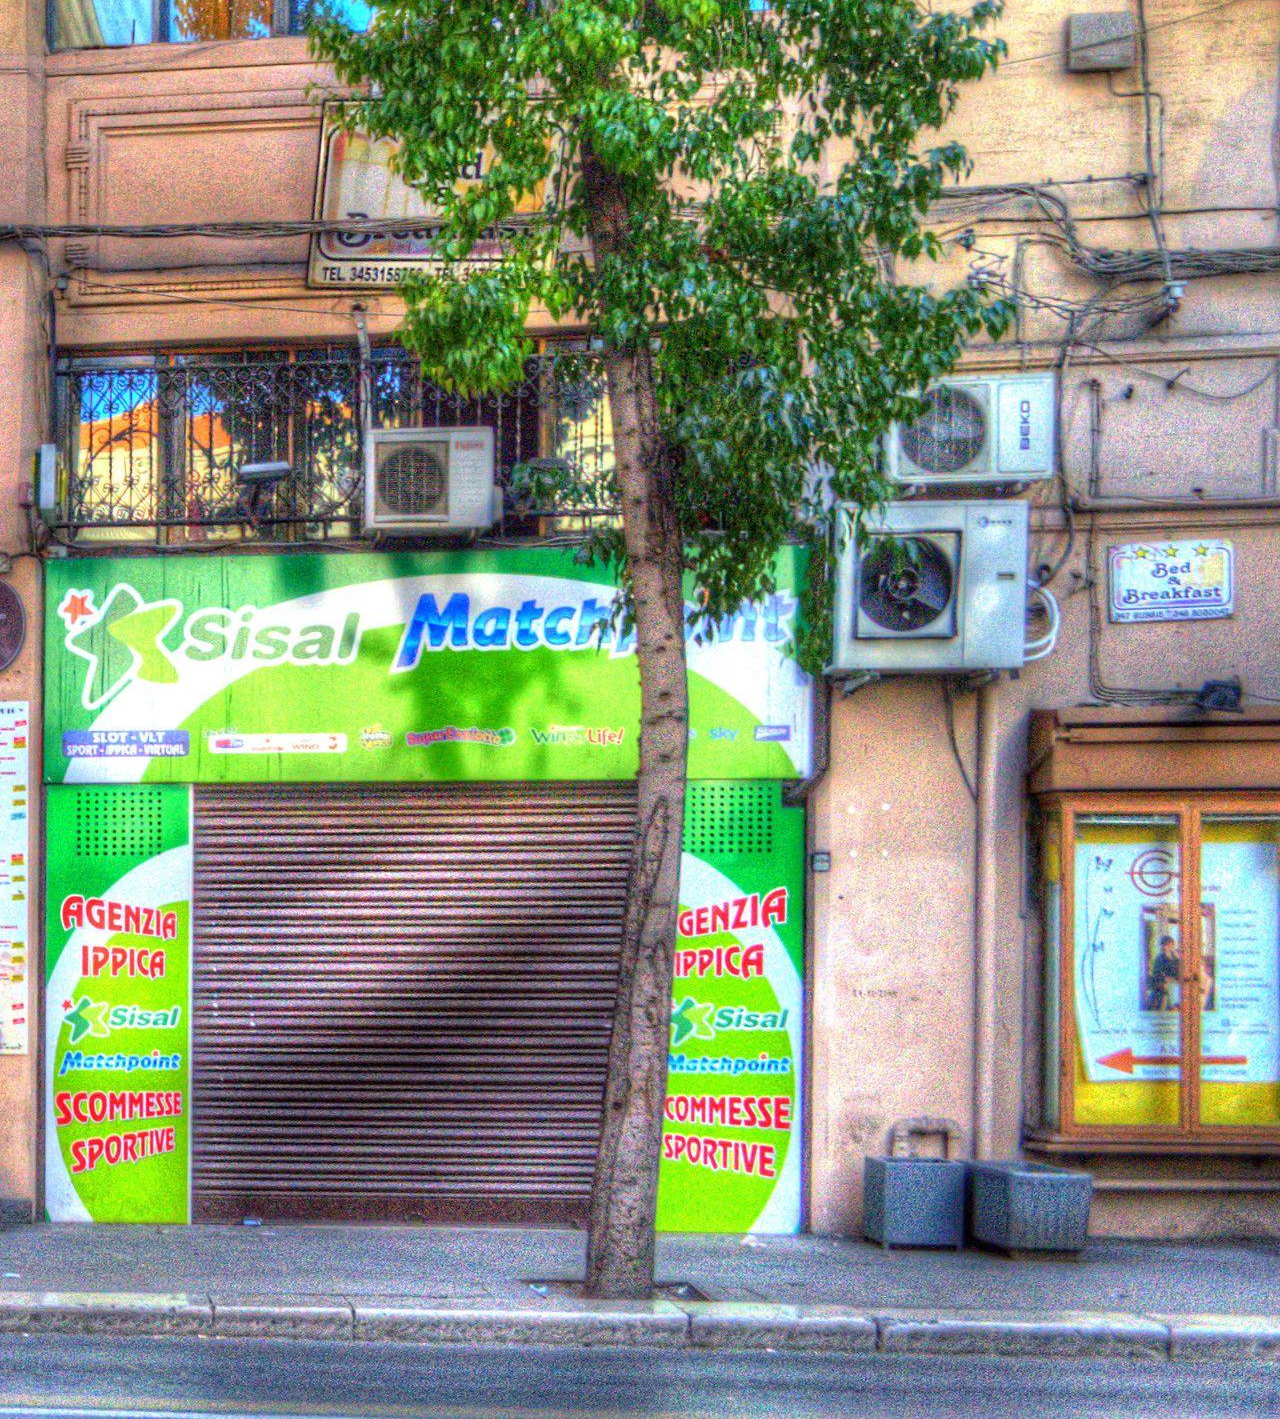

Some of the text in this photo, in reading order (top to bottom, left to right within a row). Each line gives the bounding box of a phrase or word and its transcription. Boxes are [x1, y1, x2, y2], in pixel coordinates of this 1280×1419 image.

[1019, 400, 1031, 451] BEKO
[1151, 562, 1191, 578] Bed
[1122, 586, 1222, 604] Breakfast
[184, 612, 361, 662] Sisal
[92, 732, 128, 743] SLOT
[139, 731, 166, 742] VLT
[587, 728, 625, 747] Life!
[708, 727, 738, 741] sky
[66, 745, 98, 755] SPORT
[144, 744, 186, 755] VIRTUAL
[61, 895, 178, 940] AGENZIA
[678, 888, 787, 937] GENZIA
[81, 945, 166, 980] IPPICA
[675, 943, 765, 979] IPPICA
[110, 1007, 180, 1028] Sisal
[715, 1008, 789, 1029] Sisal
[59, 1050, 181, 1075] Matchpoint
[668, 1053, 791, 1075] Matchpoint
[55, 1090, 182, 1126] SCOMMESSE
[665, 1096, 791, 1131] COMMESSE
[71, 1127, 175, 1173] SPORTIVE
[664, 1133, 776, 1178] SPORTIVE
